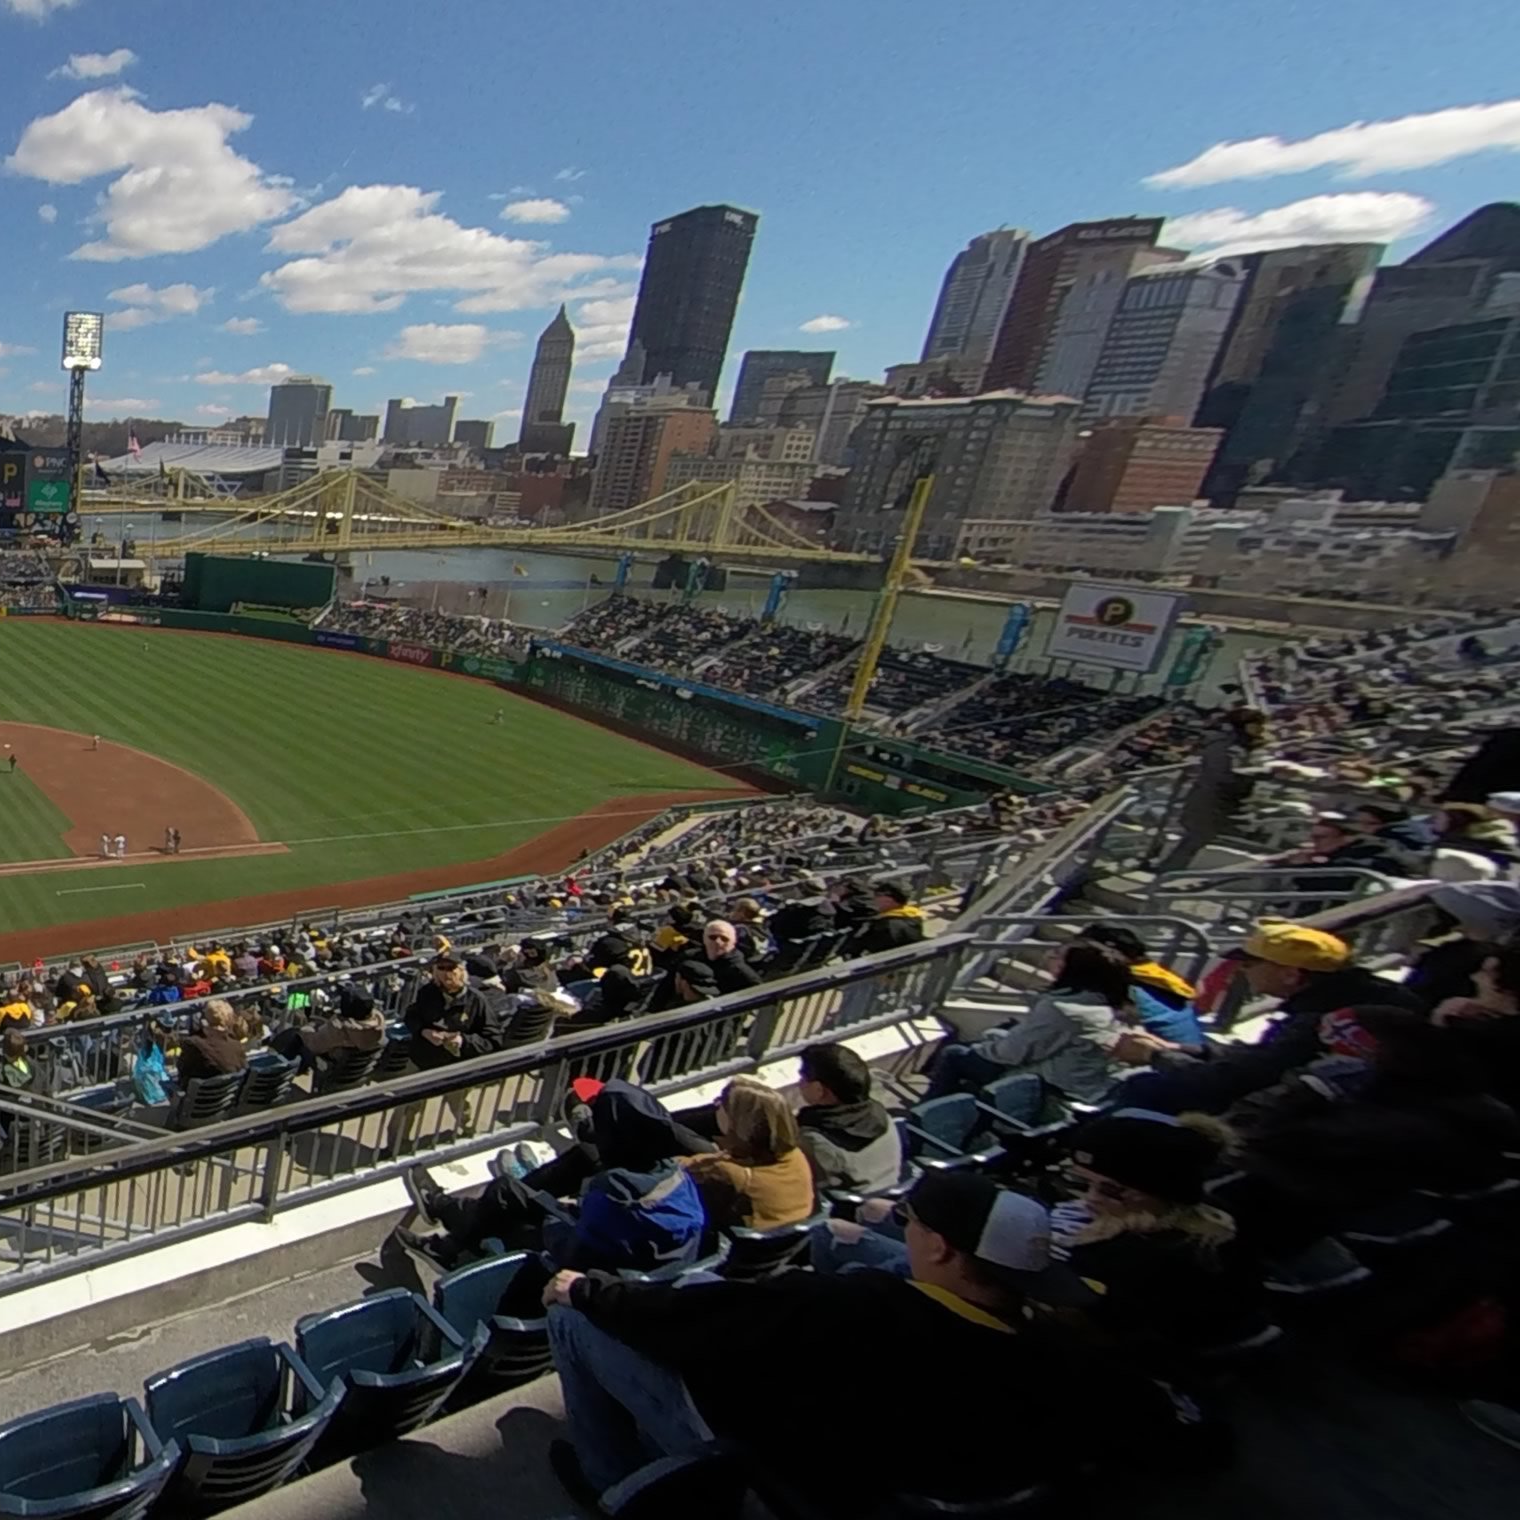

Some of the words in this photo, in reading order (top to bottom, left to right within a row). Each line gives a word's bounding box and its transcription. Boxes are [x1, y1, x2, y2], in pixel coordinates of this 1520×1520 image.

[46, 457, 67, 467] PNC
[1103, 603, 1126, 622] P
[1065, 626, 1145, 648] PIRATES
[391, 644, 430, 663] xfinity
[629, 948, 653, 976] 21
